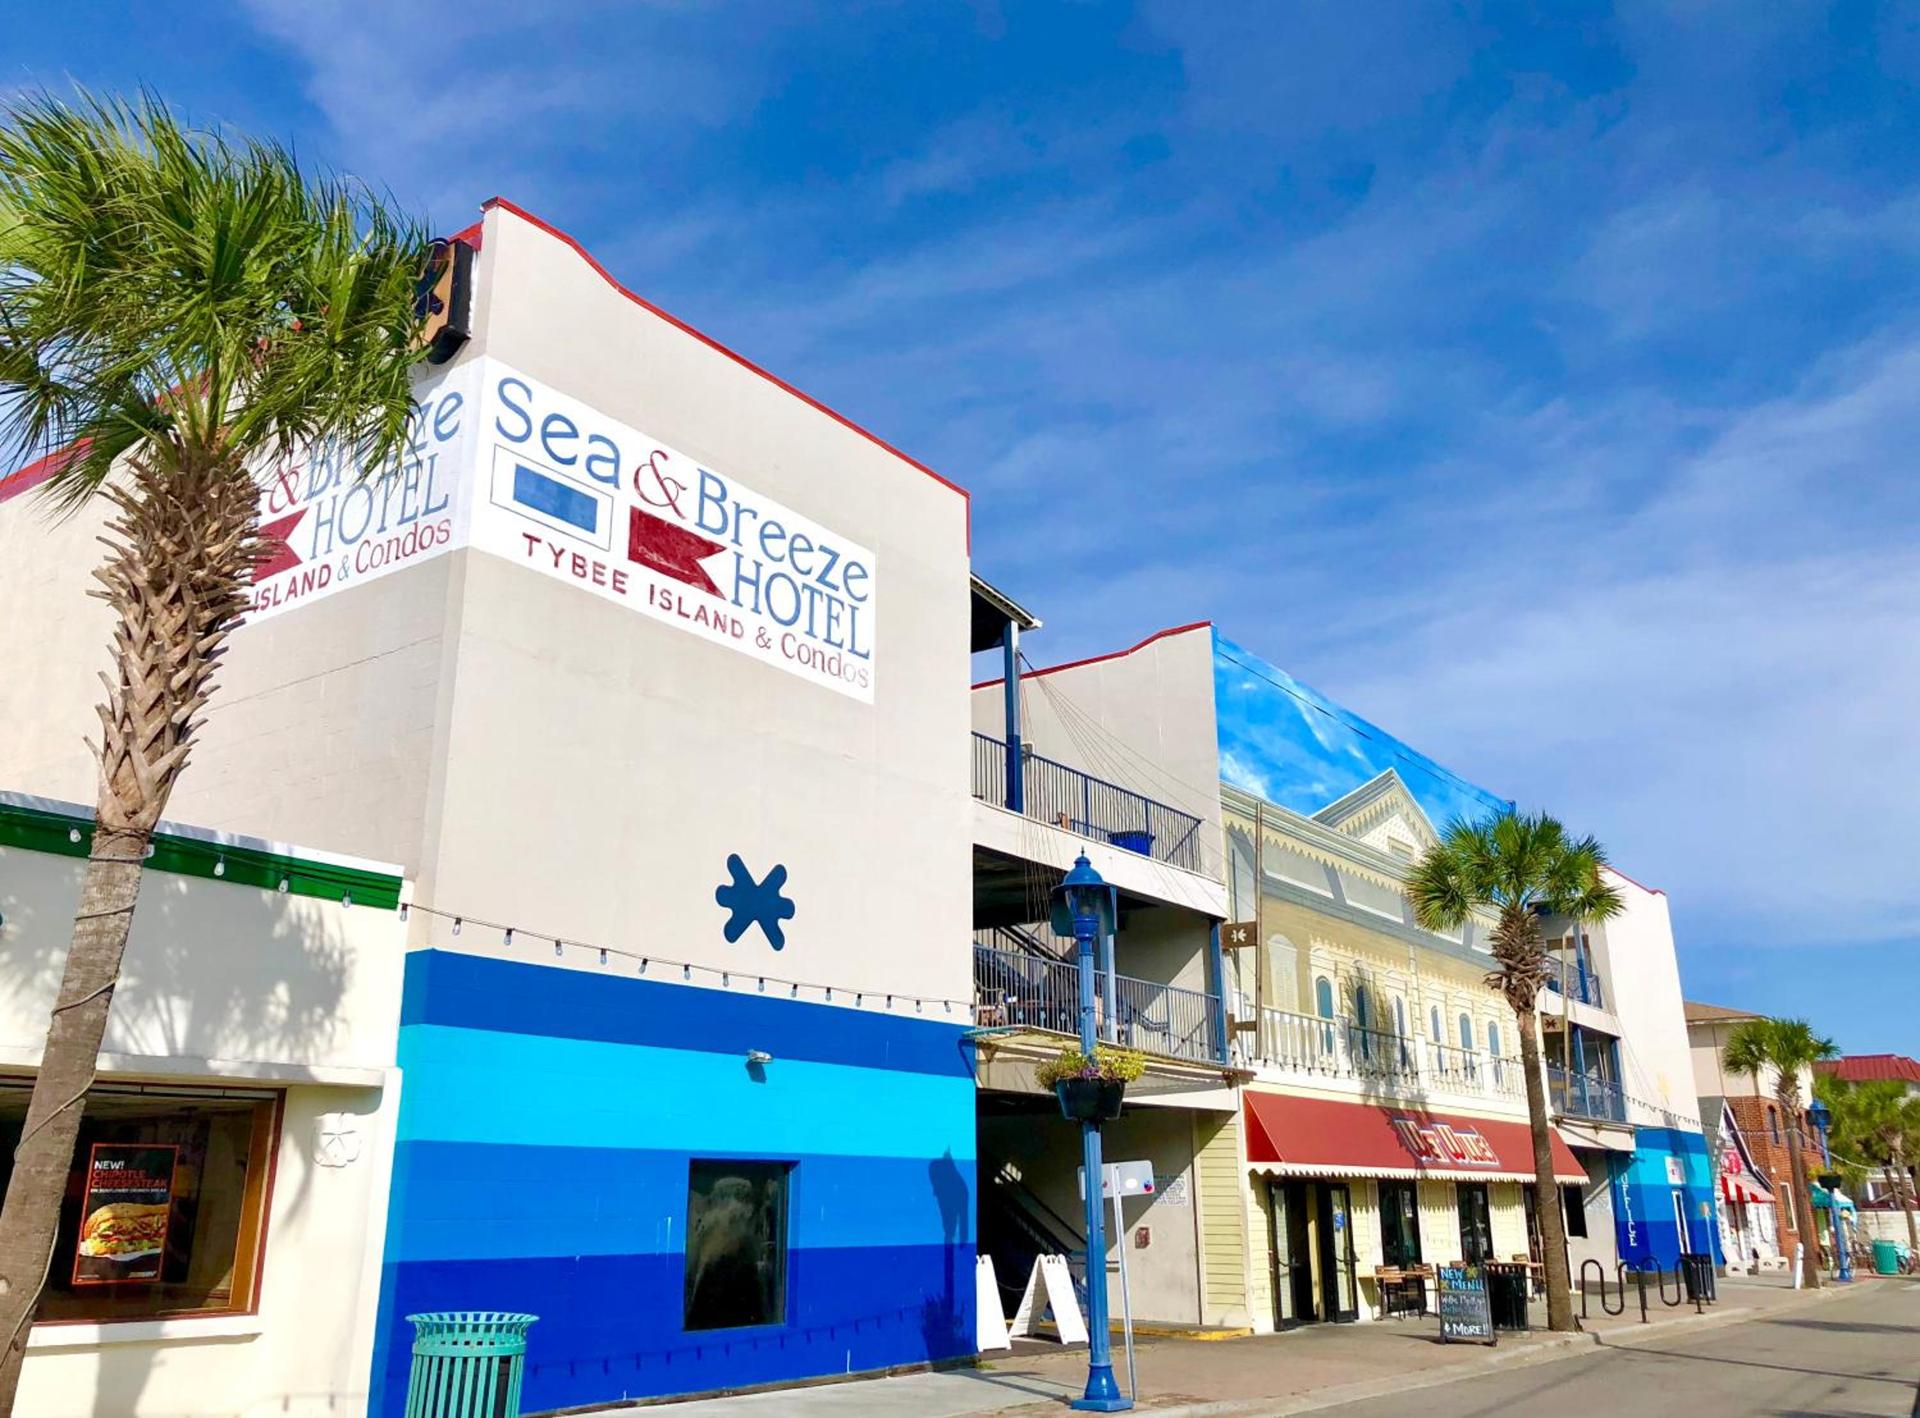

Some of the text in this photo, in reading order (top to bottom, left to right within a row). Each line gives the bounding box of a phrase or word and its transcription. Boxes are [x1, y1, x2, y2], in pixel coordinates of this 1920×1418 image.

[310, 453, 449, 560] HOTEL
[495, 377, 869, 602] Sea & Breeze
[253, 518, 451, 613] ISLAND & Condos
[522, 532, 629, 595] TYBEE
[649, 584, 744, 639] ISLAND
[756, 627, 772, 649] &
[781, 632, 869, 689] Condos
[731, 551, 870, 660] HOTEL
[92, 1170, 146, 1178] CHIPOTLE
[94, 1160, 125, 1170] NEW!
[1440, 1268, 1463, 1279] NEW
[1452, 1279, 1484, 1290] MENU
